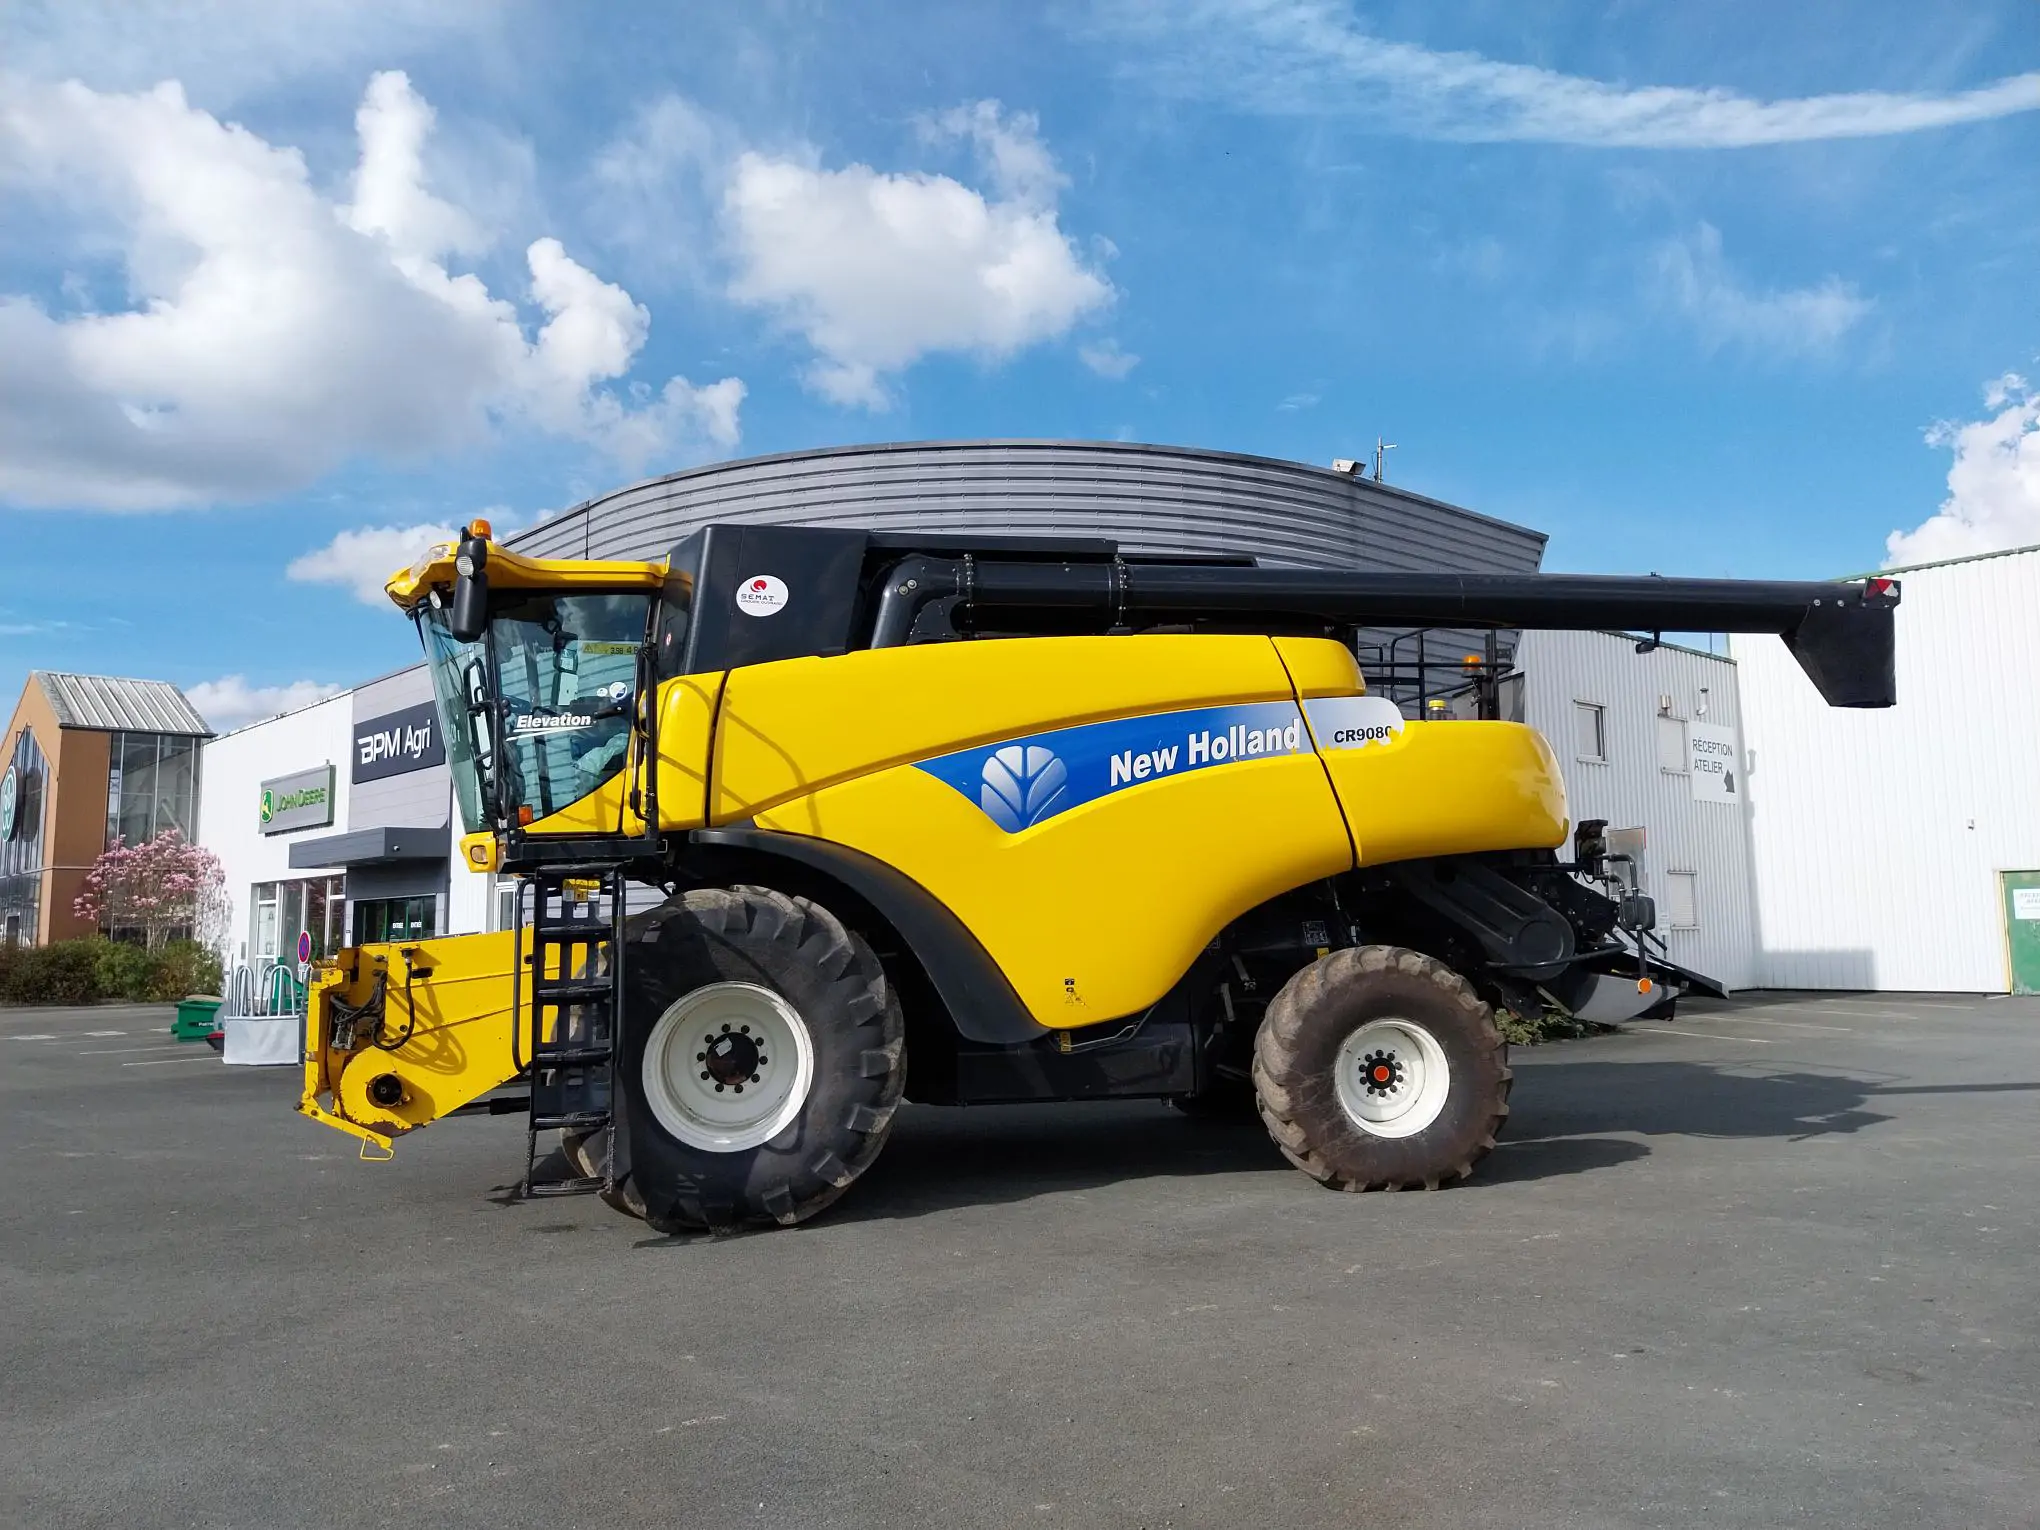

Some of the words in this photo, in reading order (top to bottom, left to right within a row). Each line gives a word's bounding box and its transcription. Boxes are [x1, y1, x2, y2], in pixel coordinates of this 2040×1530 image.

[740, 593, 775, 602] SEMAT
[515, 713, 592, 729] Elevation
[357, 726, 401, 765] BPM
[403, 718, 432, 759] Agri
[1692, 736, 1733, 757] RÉCEPTION
[1109, 744, 1179, 787] New
[1187, 717, 1301, 765] Holland
[1693, 758, 1724, 775] ATELIER
